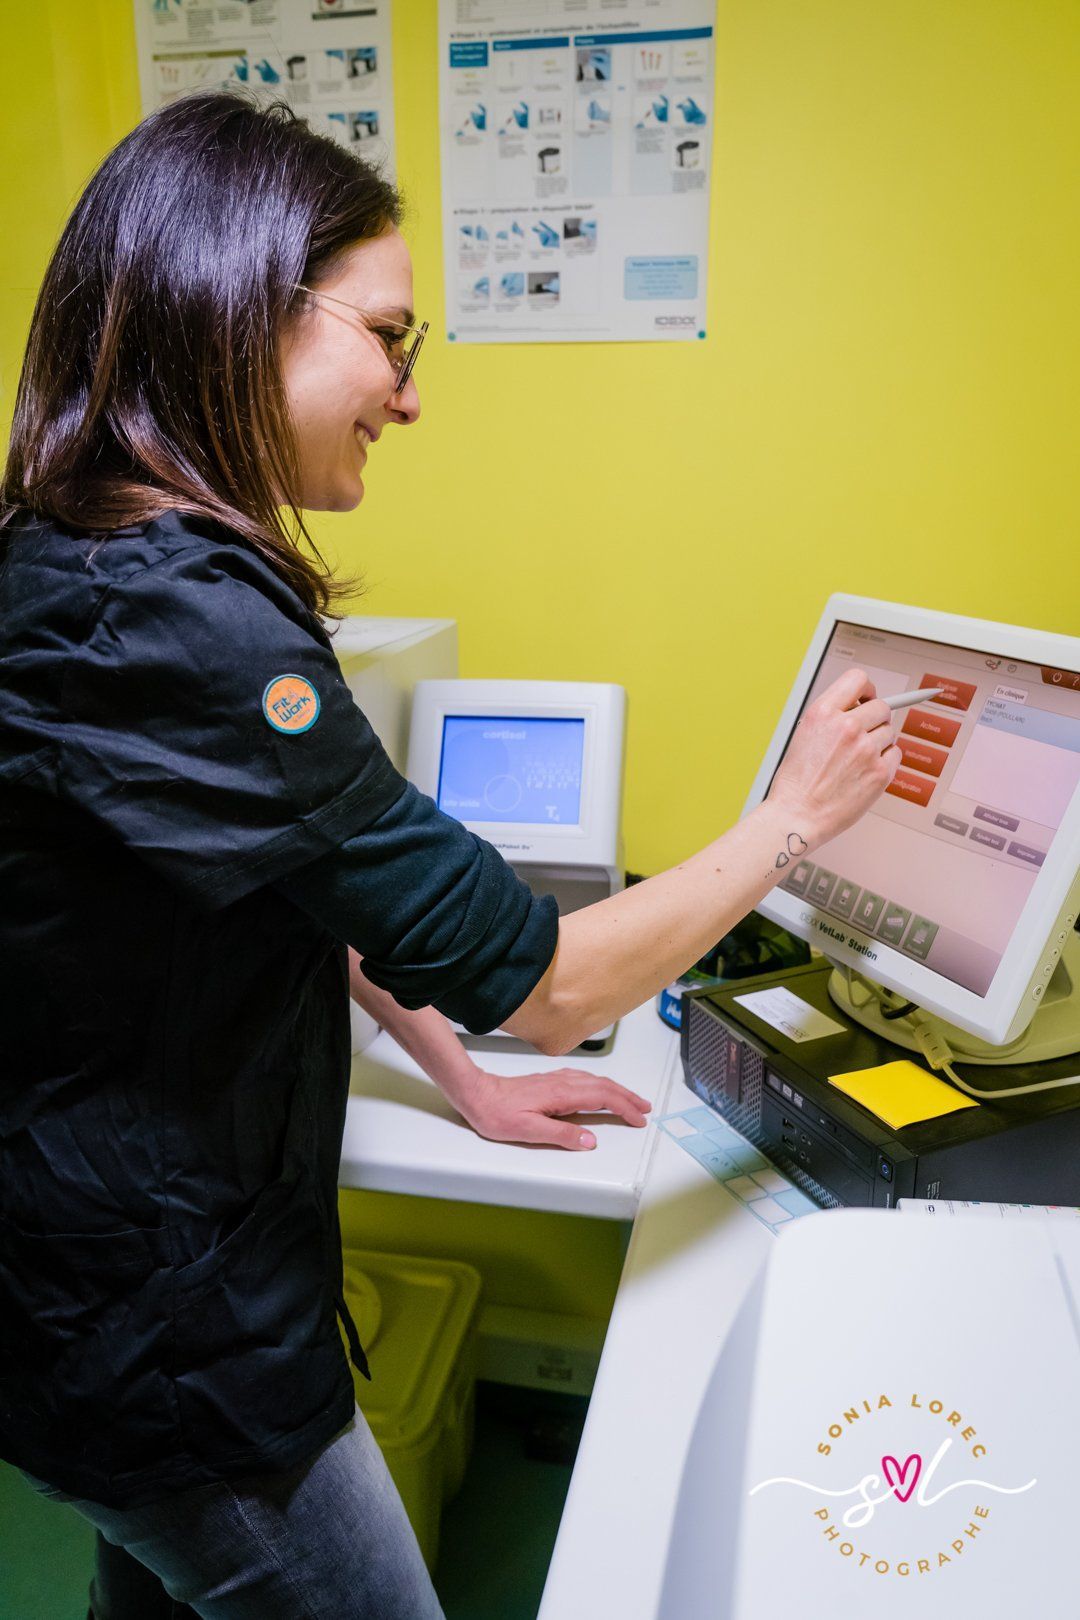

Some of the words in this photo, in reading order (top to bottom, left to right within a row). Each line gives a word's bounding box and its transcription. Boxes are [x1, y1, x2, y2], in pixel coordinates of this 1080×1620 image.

[482, 730, 527, 740] cortisol
[818, 921, 846, 943] VetLab
[847, 937, 878, 961] Station
